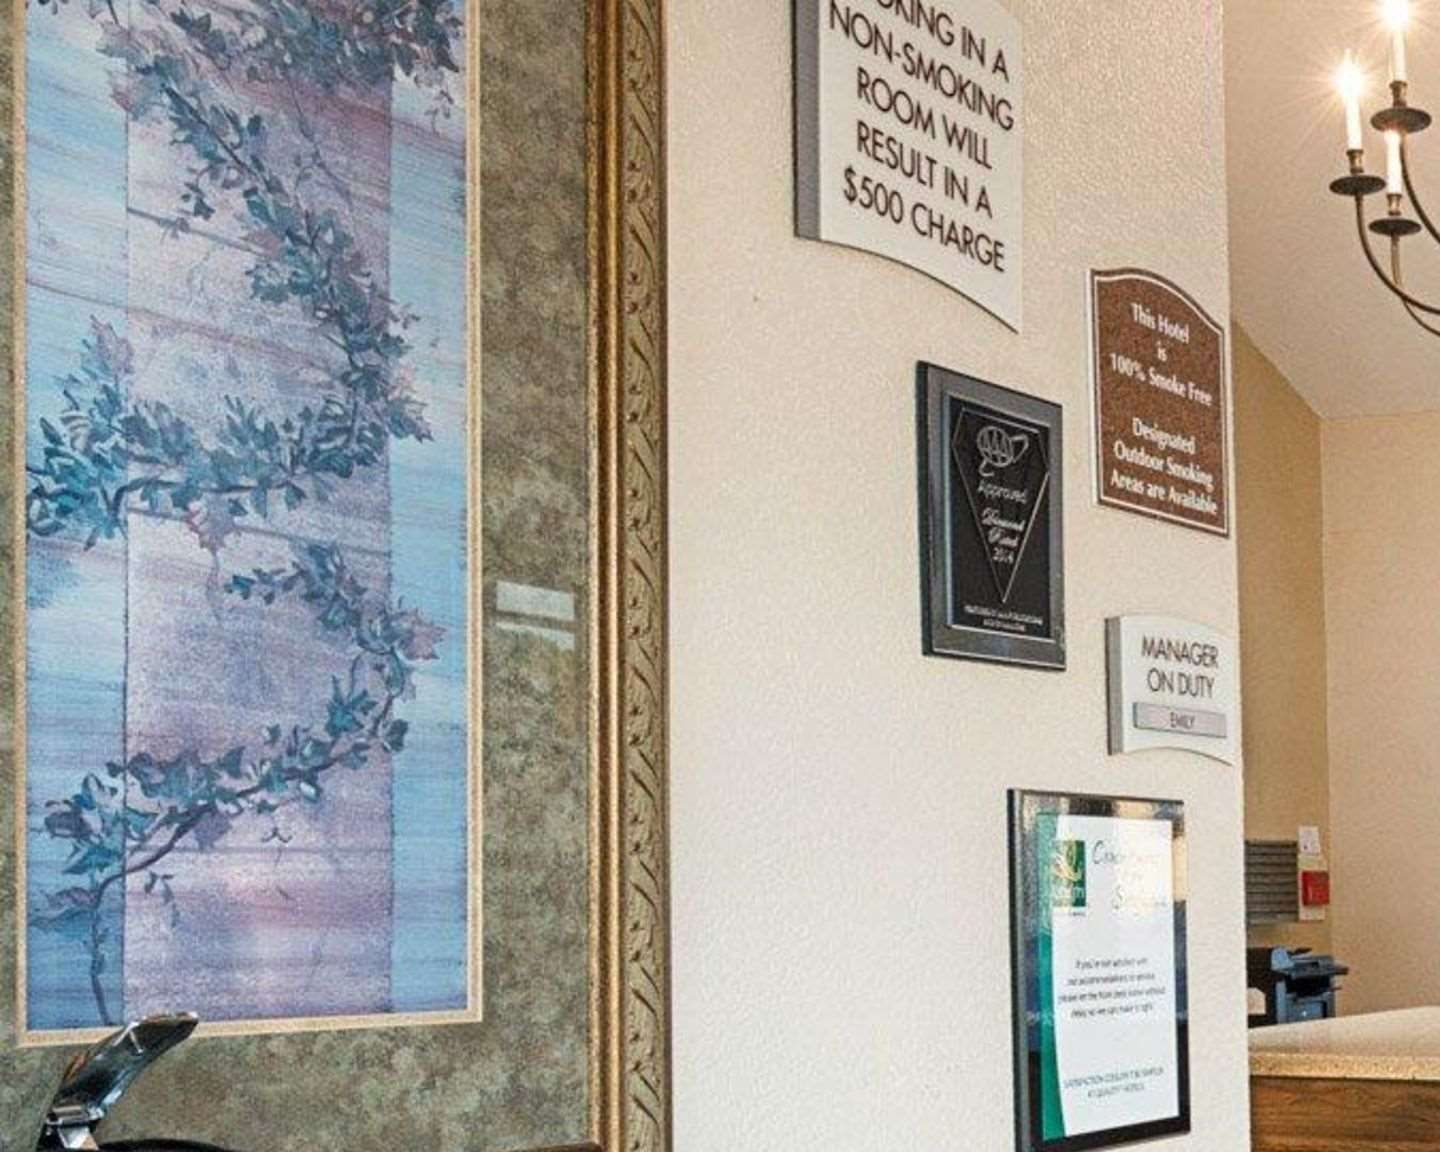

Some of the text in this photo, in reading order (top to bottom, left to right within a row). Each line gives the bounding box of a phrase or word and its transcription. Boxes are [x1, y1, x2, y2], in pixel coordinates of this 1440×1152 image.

[829, 0, 1014, 131] NON-SMOKING
[877, 0, 1009, 82] KING IN A
[857, 67, 992, 169] ROOM WILL
[857, 119, 992, 218] RESULT IN A
[843, 165, 1004, 272] $500 CHARGE
[1131, 302, 1189, 344] This Hotel
[1109, 353, 1213, 406] 100% Smoke Free
[1132, 416, 1196, 454] Designated
[1110, 468, 1217, 516] Areas are Available
[1113, 439, 1213, 493] Outdoor Smoking
[1141, 635, 1219, 668] MANAGER
[1147, 667, 1215, 698] ON DUTY
